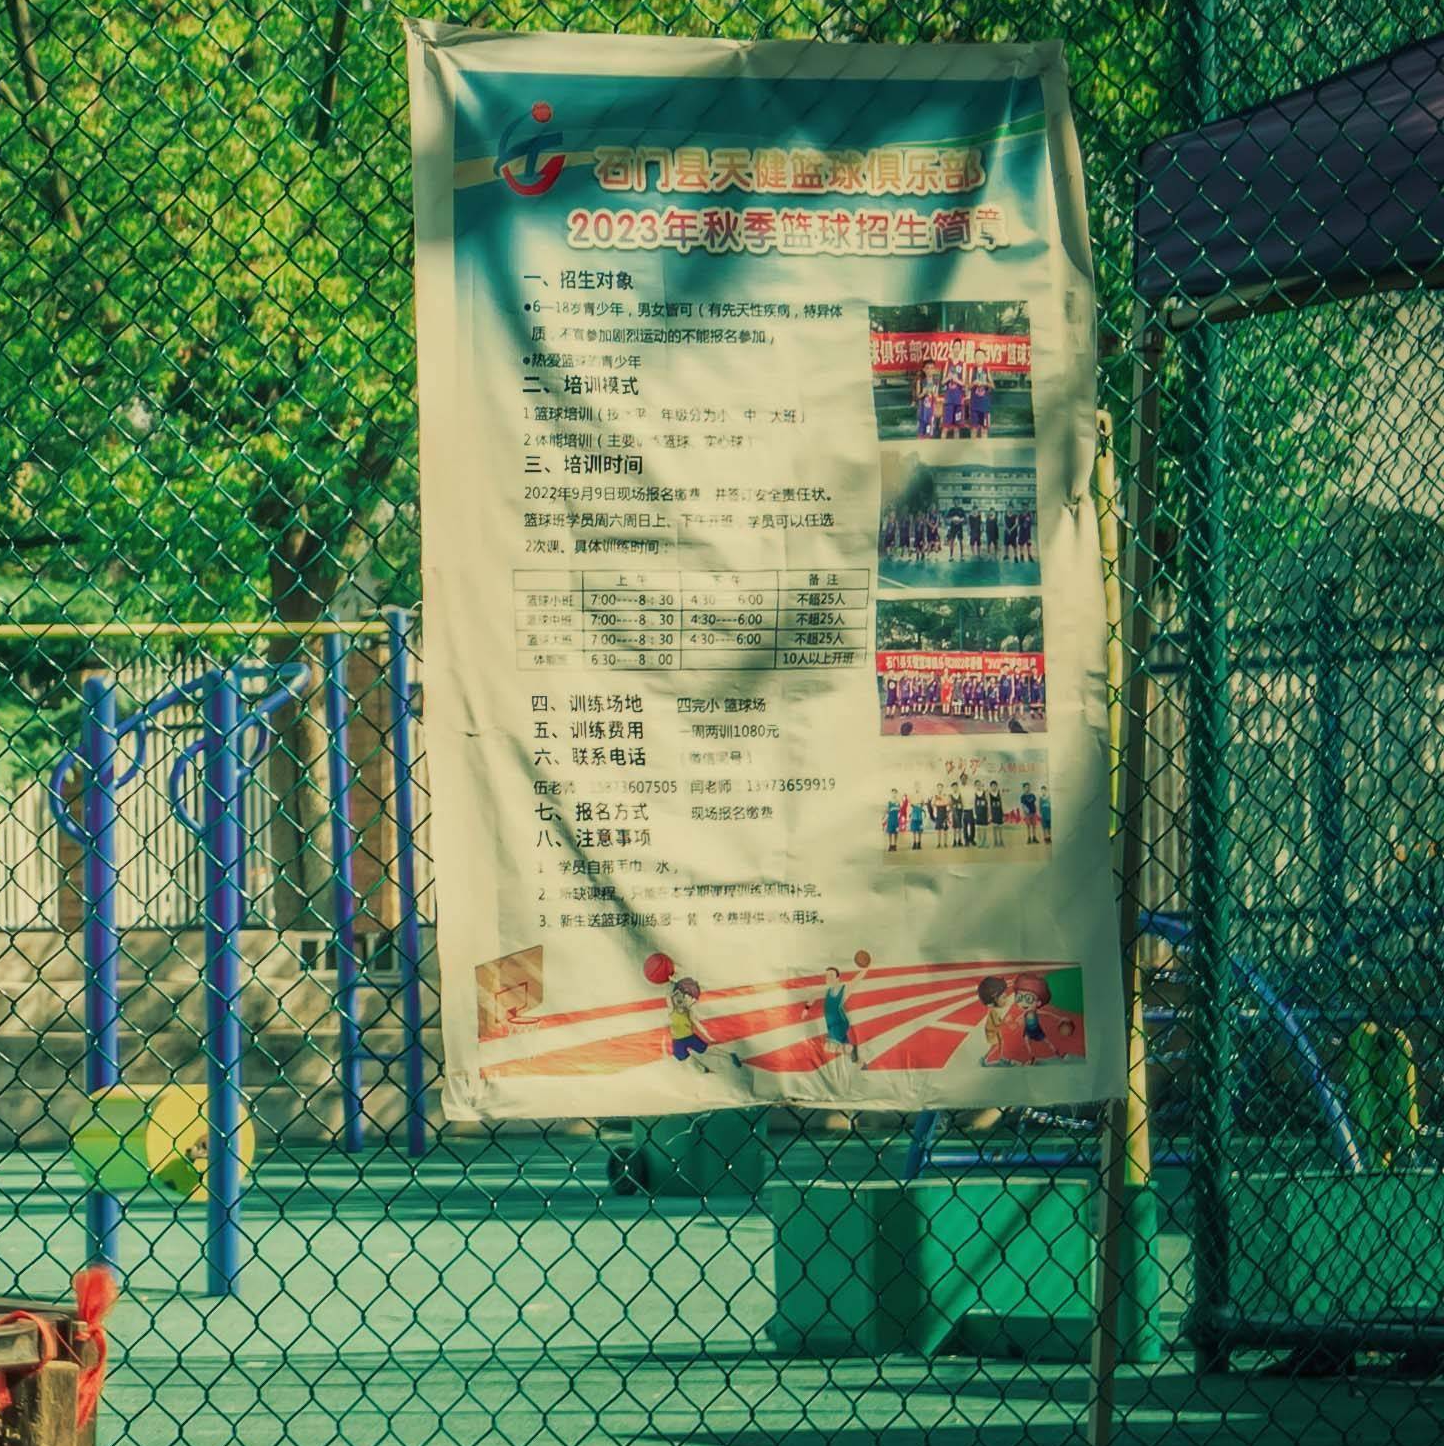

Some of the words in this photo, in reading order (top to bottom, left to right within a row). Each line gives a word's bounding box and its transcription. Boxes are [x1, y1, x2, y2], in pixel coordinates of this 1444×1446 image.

[595, 146, 984, 192] 石门县天健篮球俱乐部
[570, 208, 1008, 252] 2023年秋季篮球招生简章
[523, 270, 635, 291] 一、招生对象
[522, 374, 640, 396] 二、培训模式
[524, 454, 644, 475] 三、培训时间
[531, 694, 644, 713] 四、训练场地
[533, 720, 644, 740] 五、训练费用
[534, 747, 647, 767] 六、联系电话
[534, 802, 650, 822] 七、报名方式
[536, 828, 653, 848] 八、注意事项
